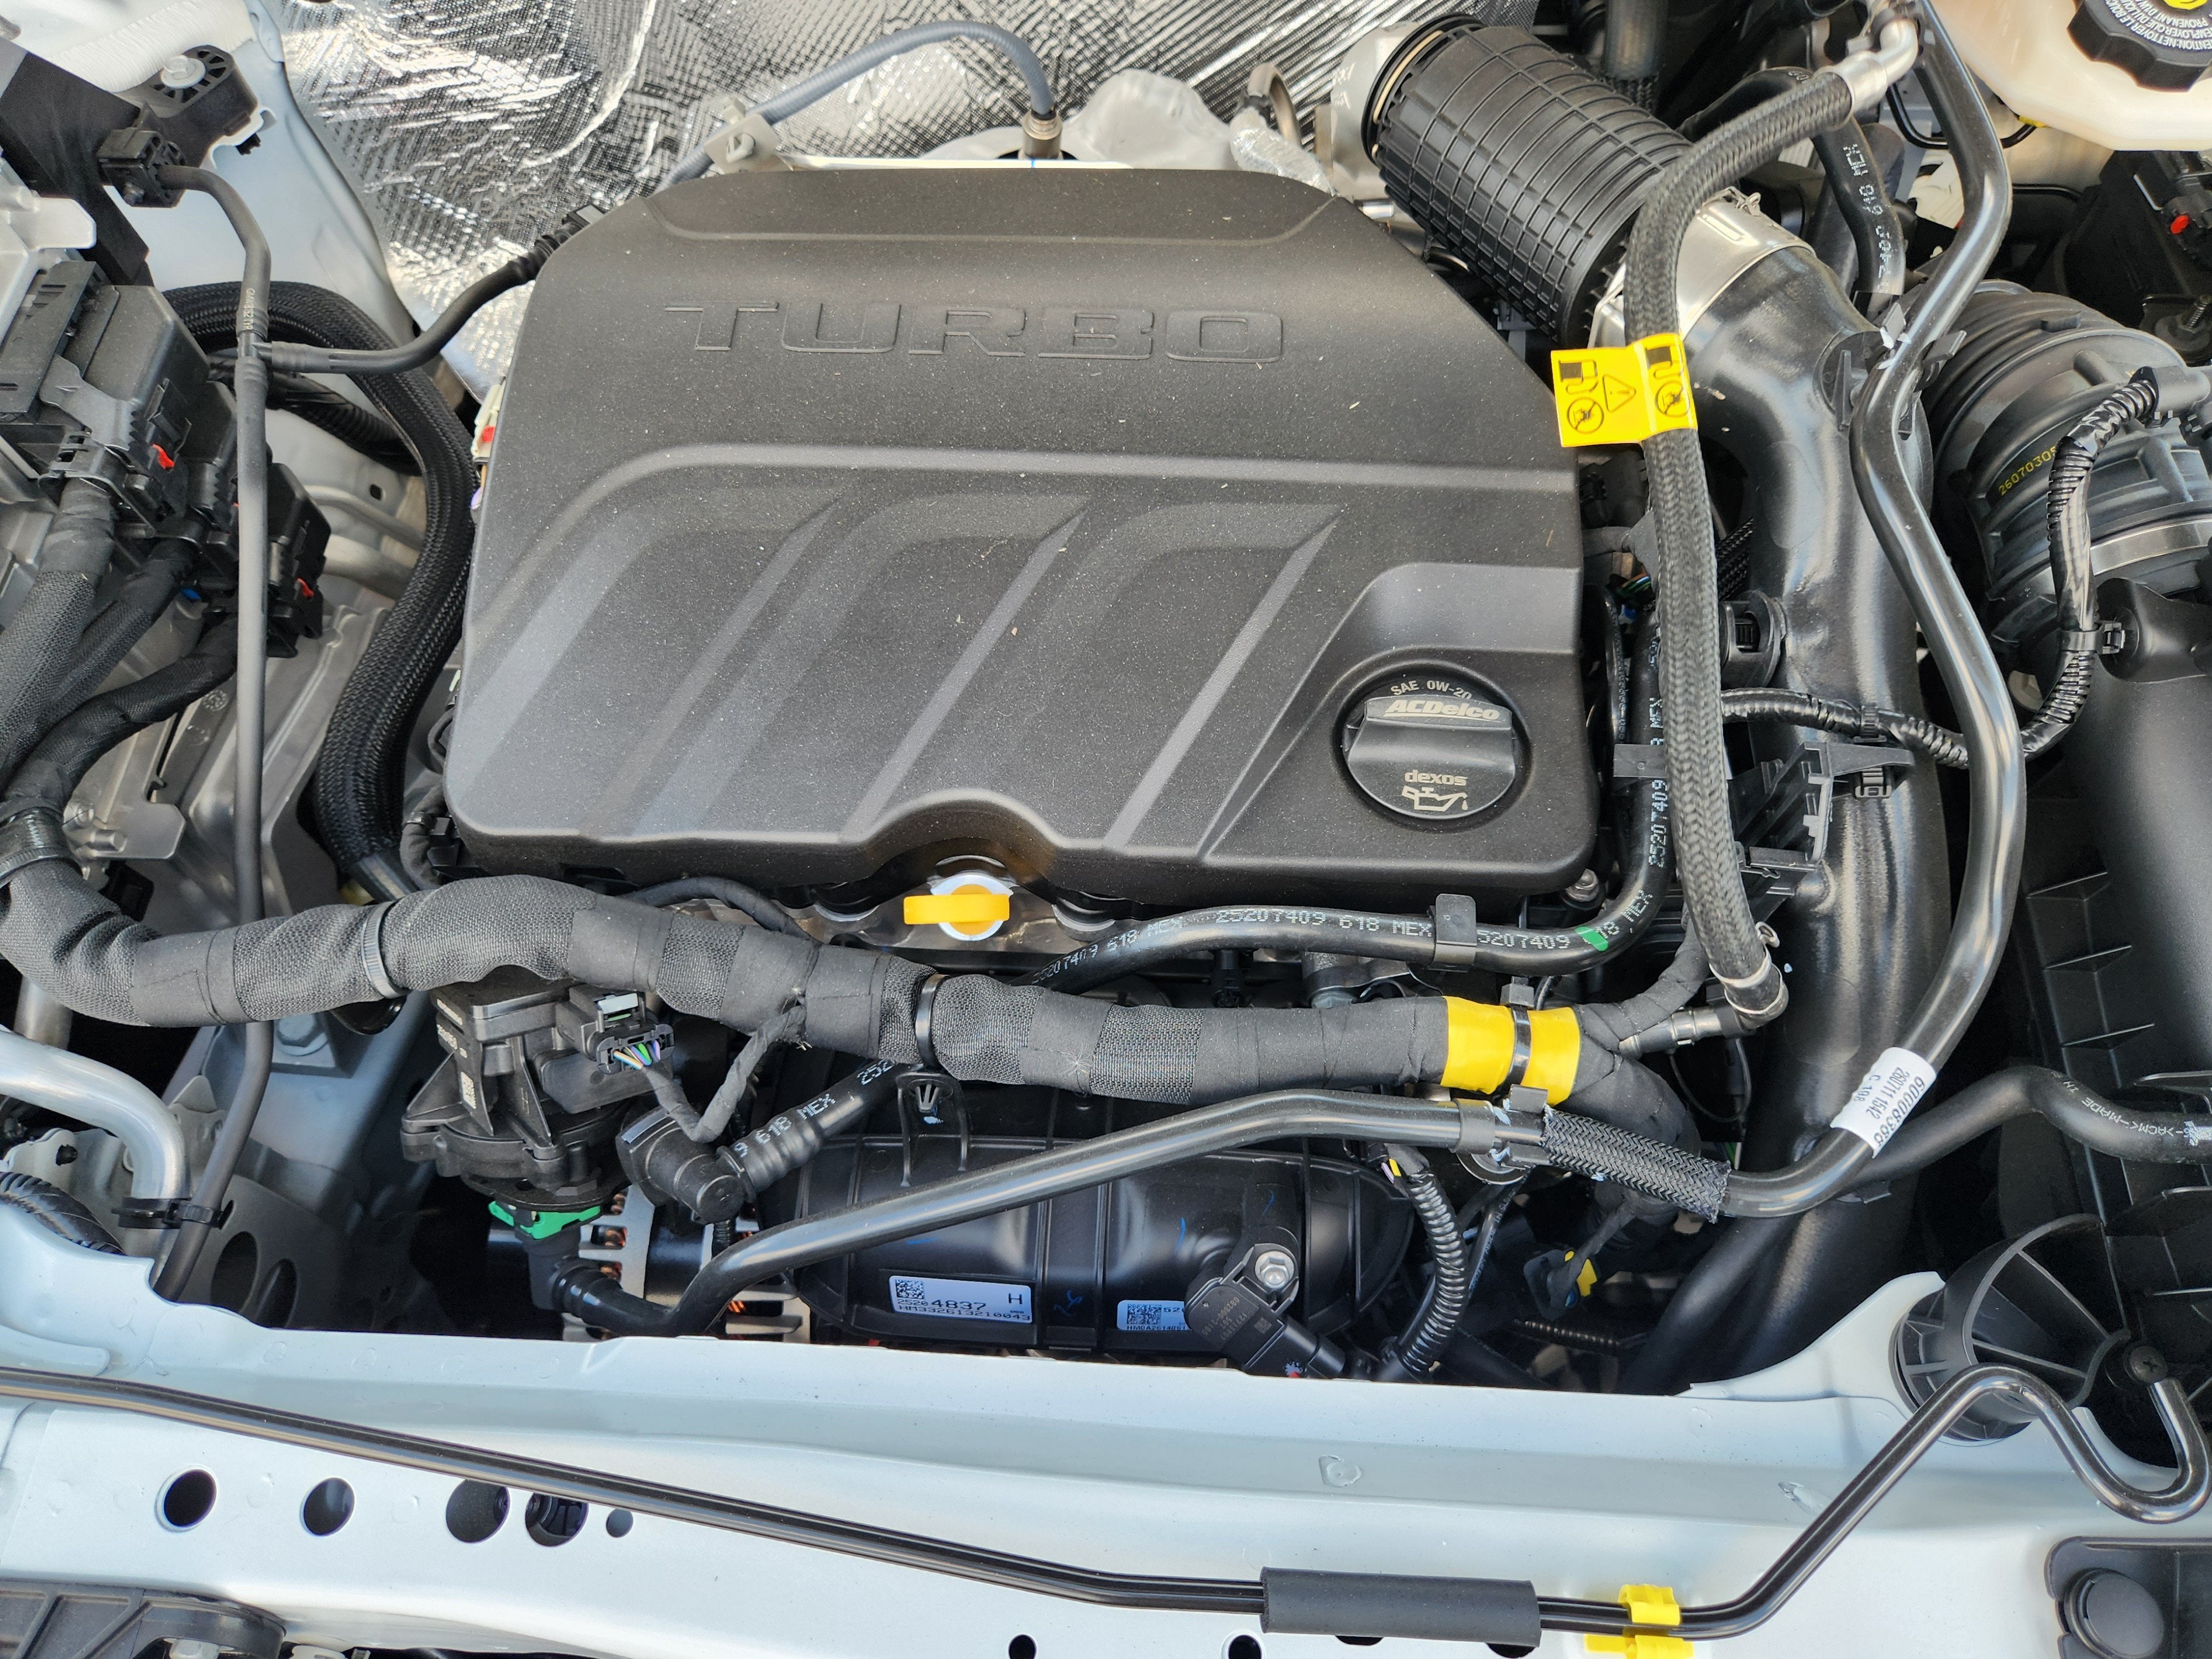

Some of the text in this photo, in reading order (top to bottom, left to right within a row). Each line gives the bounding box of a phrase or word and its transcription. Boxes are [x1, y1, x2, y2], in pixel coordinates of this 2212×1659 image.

[2105, 0, 2127, 18] BOUC
[2120, 0, 2212, 39] EMPLOYER QUE DU LIQU
[2120, 15, 2136, 27] LE
[2153, 12, 2209, 28] PROVENANT
[2177, 39, 2212, 51] ENTION:
[664, 301, 1284, 363] TURBO
[1390, 680, 1472, 700] SAE 0W-20
[1385, 699, 1500, 720] ACDelco
[1404, 769, 1469, 786] dexos
[1215, 908, 1327, 926] 25207409
[1339, 915, 1380, 932] 618
[1392, 920, 1433, 937] MEX
[1476, 929, 1571, 950] 5207409
[1620, 889, 1653, 923] MEX
[1865, 1067, 1910, 1119] 260711 1542
[796, 1093, 836, 1120] MEX
[1008, 1292, 1022, 1305] H
